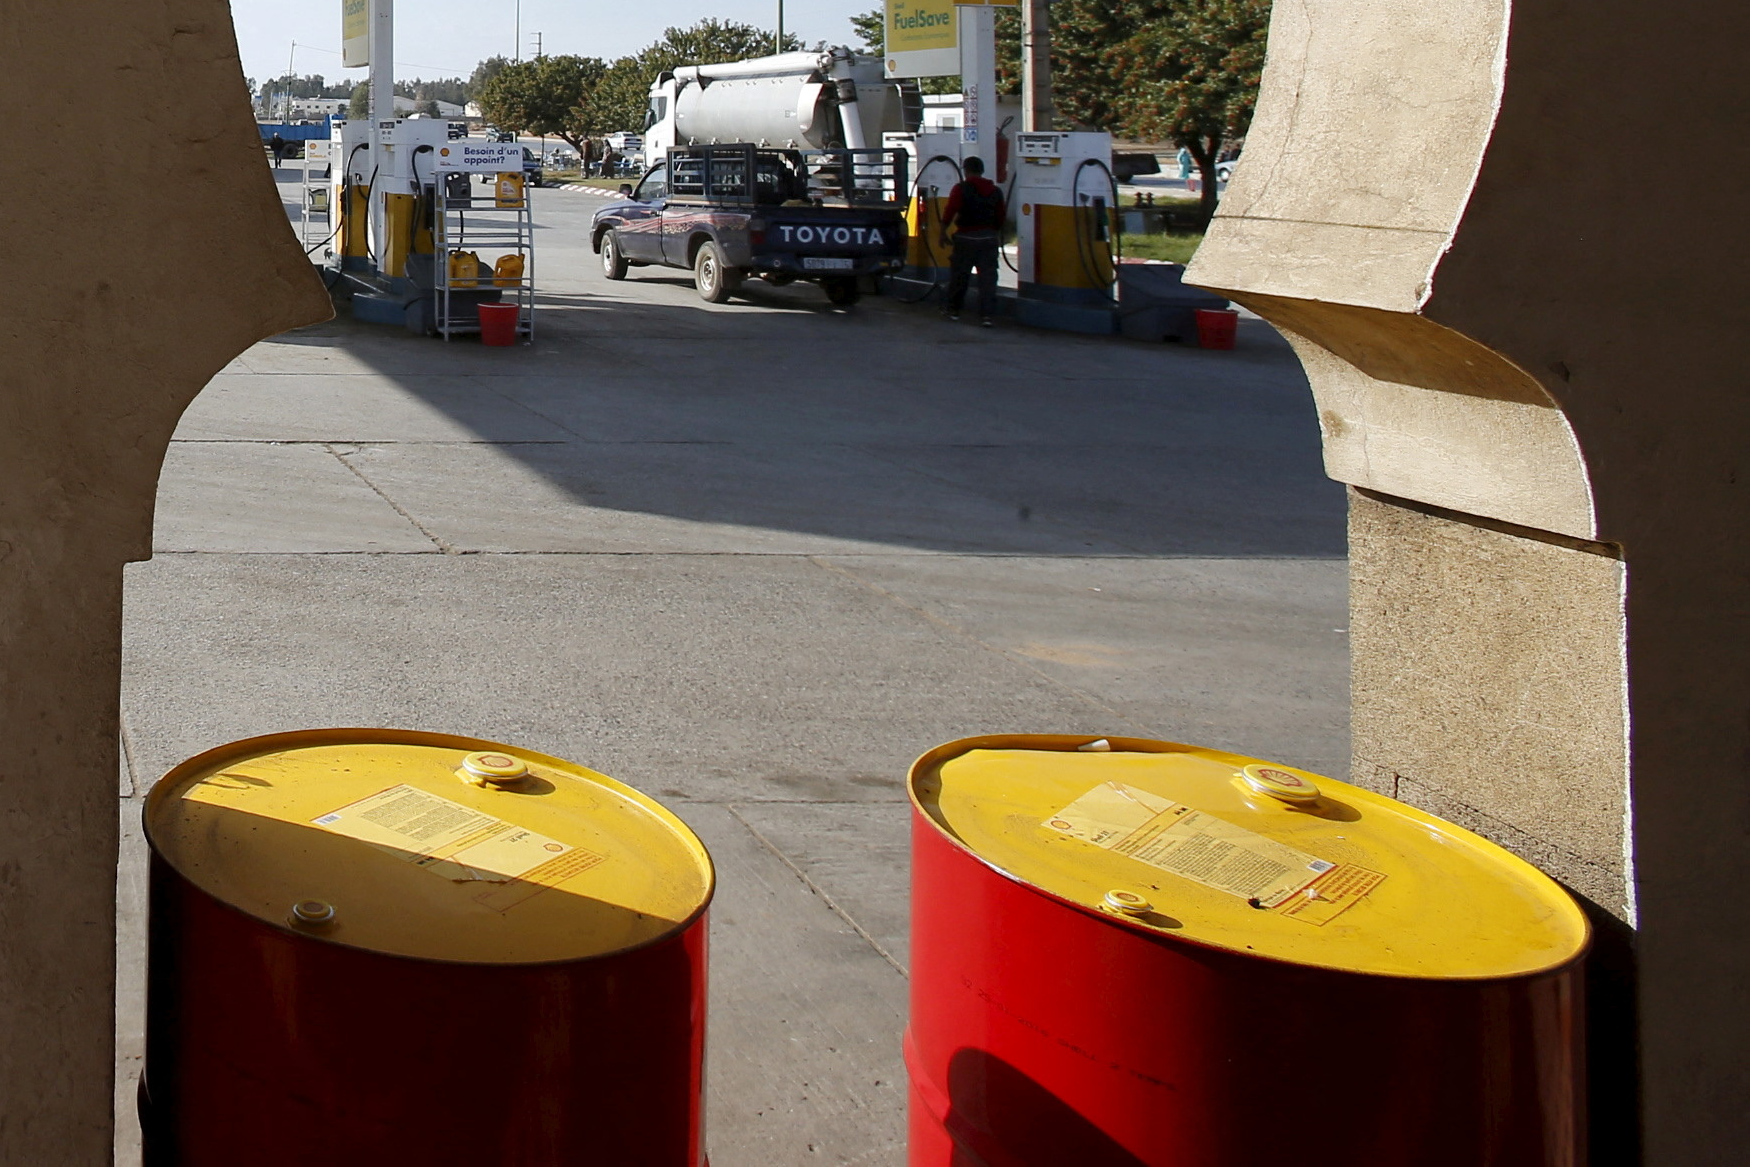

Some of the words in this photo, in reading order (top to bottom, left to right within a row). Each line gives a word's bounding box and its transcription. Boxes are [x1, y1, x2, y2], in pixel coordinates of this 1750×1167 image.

[894, 9, 950, 30] FuelSave
[464, 146, 493, 155] Besoin
[497, 146, 519, 155] d'un
[463, 156, 505, 165] appoint?
[779, 225, 885, 245] TOYOTA
